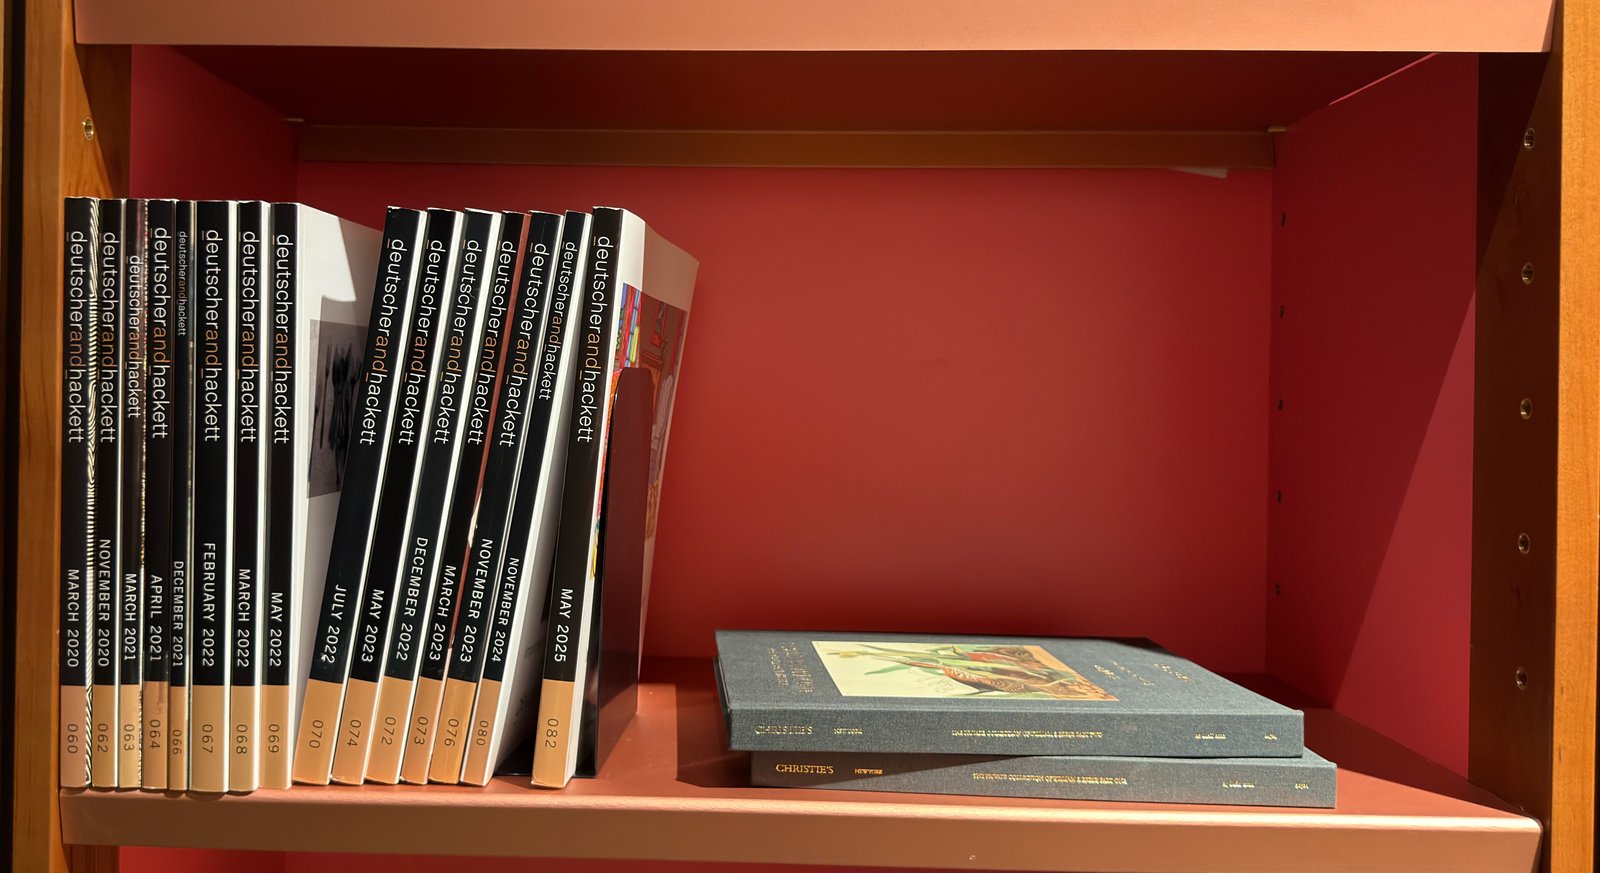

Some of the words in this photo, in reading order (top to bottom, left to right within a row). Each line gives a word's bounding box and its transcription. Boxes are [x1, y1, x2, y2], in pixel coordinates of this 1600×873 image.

[65, 231, 87, 443] deutscherandhackett
[98, 232, 119, 443] deutscherandhackett
[126, 255, 142, 418] deutscherandhackett
[149, 227, 171, 438] deutscherandhackett
[201, 229, 223, 442] deutscherandhackett
[238, 231, 259, 443] deutscherandhackett
[271, 234, 293, 444] deutscherandhackett
[538, 241, 577, 401] deutscherandhackett
[577, 236, 613, 443] deutscherandhackett
[360, 238, 407, 446] deutscherandhackett
[398, 239, 446, 445] deutscherandhackett
[434, 239, 482, 444] deutscherandhackett
[467, 240, 516, 445] deutscherandhackett
[499, 242, 549, 447] deutscherandhackett
[67, 569, 80, 622] MARCH
[98, 539, 111, 621] NOVEMBER
[150, 574, 162, 618] APRIL
[173, 561, 184, 631] DECEMBER
[202, 542, 216, 622] FEBRUARY
[238, 568, 251, 622] MARCH
[403, 537, 428, 617] DECEMBER
[438, 565, 456, 617] MARCH
[468, 538, 493, 619] NOVEMBER
[498, 557, 519, 625] NOVEMBER
[124, 573, 137, 621] MARCH
[270, 592, 283, 622] MAY
[331, 584, 347, 621] JULY
[369, 588, 384, 620] MAY
[559, 588, 573, 619] MAY
[67, 631, 79, 668] 2020
[97, 630, 109, 667] 2020
[124, 630, 136, 661] 2021
[149, 625, 162, 661] 2021
[172, 637, 183, 667] 2021
[202, 630, 214, 667] 2022
[237, 630, 249, 667] 2022
[269, 630, 282, 667] 2022
[325, 625, 341, 664] 2022
[361, 624, 378, 663] 2023
[396, 622, 413, 661] 2022
[429, 623, 446, 661] 2023
[460, 624, 477, 663] 2023
[491, 630, 506, 663] 2024
[554, 625, 570, 663] 2025
[67, 723, 79, 754] 060
[97, 723, 108, 753] 062
[123, 723, 135, 752] 063
[149, 719, 161, 749] 064
[172, 729, 182, 755] 066
[202, 723, 213, 754] 067
[236, 723, 248, 755] 068
[268, 723, 280, 753] 069
[309, 719, 324, 749] 070
[347, 719, 361, 746] 074
[381, 717, 396, 746] 072
[414, 717, 428, 745] 073
[444, 718, 459, 747] 076
[476, 720, 489, 746] 080
[544, 718, 559, 748] 082
[775, 764, 834, 774] CHRISTIE'S
